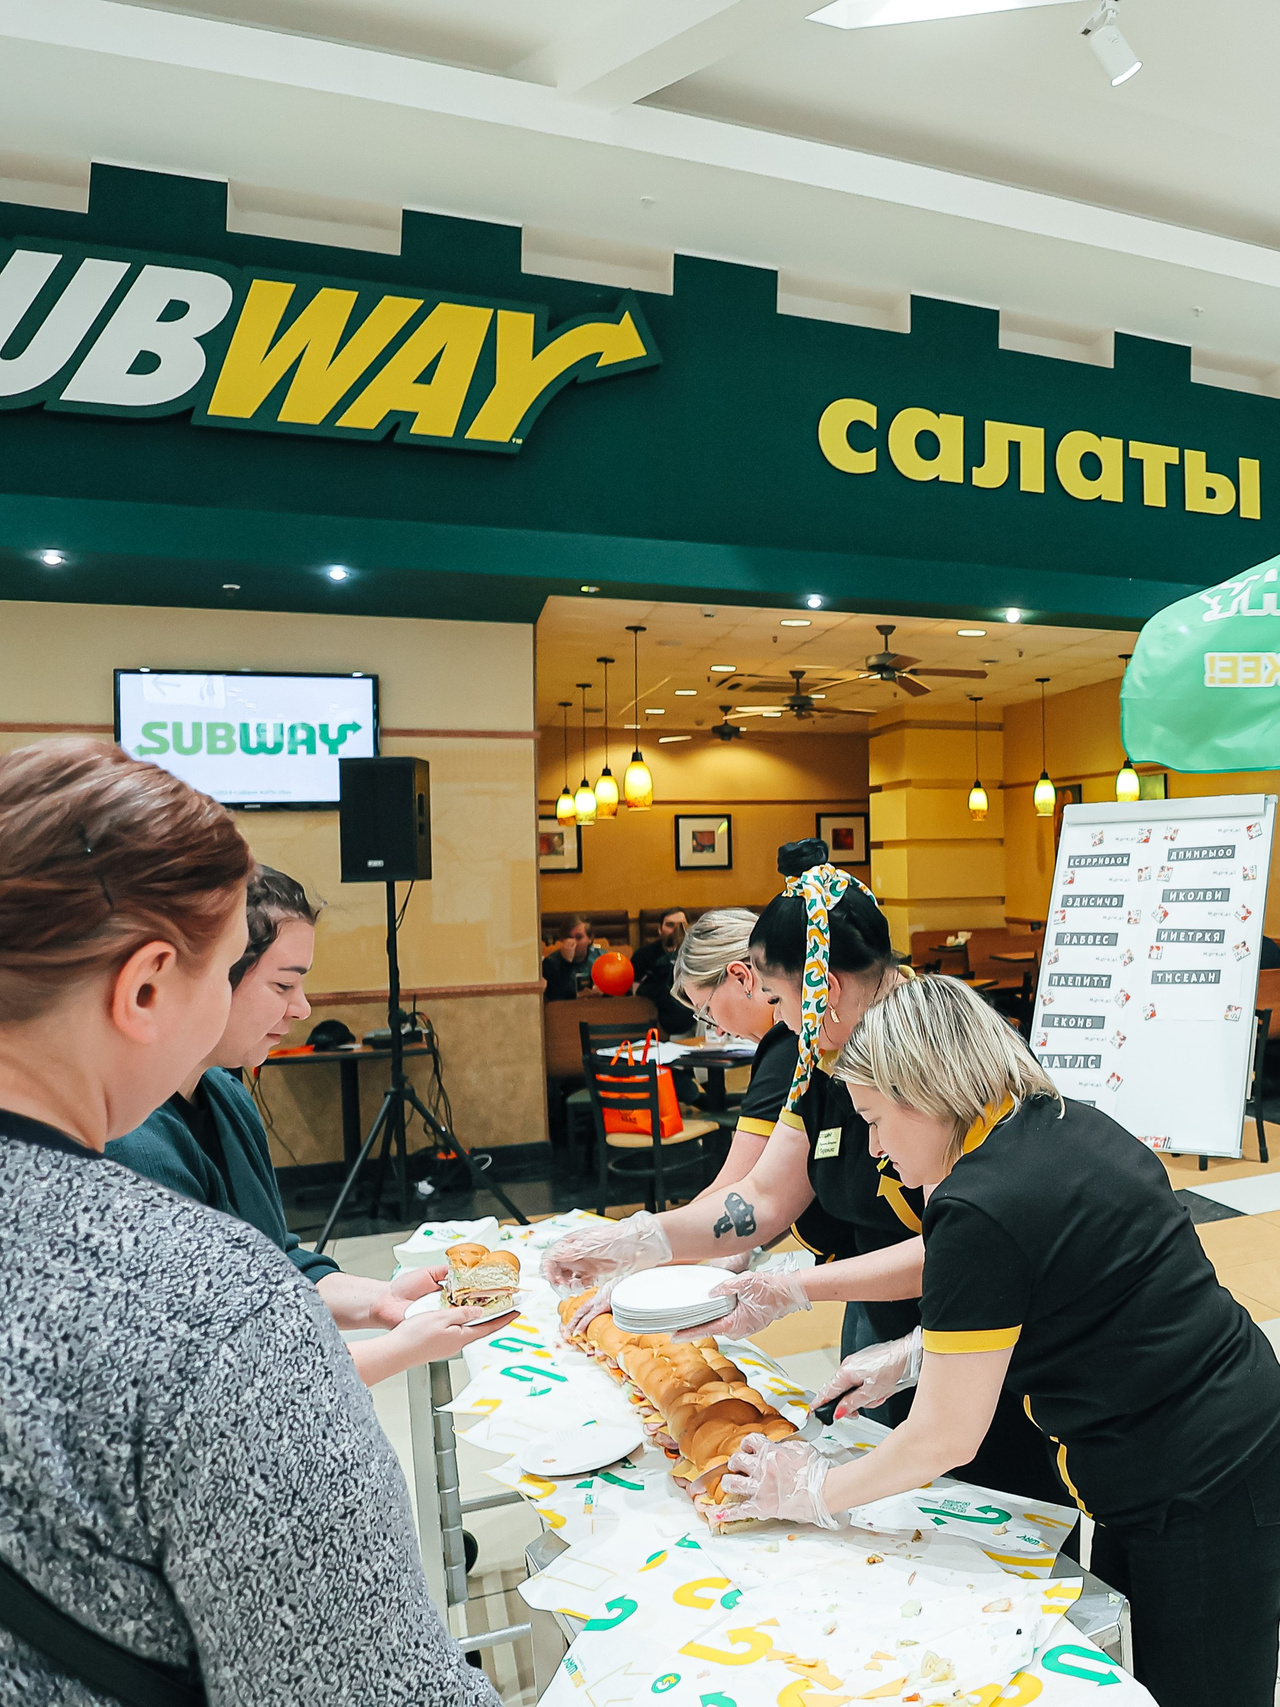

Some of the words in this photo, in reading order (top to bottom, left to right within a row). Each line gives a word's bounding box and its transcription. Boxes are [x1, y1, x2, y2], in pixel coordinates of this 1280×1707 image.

[817, 398, 1261, 520] салаты
[132, 721, 362, 757] SUBWAY
[1066, 896, 1118, 907] ЭДНСИЧВ
[1169, 890, 1222, 902] ИКОЛВИ
[1063, 933, 1109, 945] ЙАБВЕС
[1160, 931, 1221, 942] ИИЕТРКЯ
[1051, 975, 1108, 987] ПАЕПИТТ
[1156, 972, 1216, 983] ТМСЕААН
[1053, 1016, 1092, 1028] ЕКОНБ
[1041, 1055, 1096, 1068] ААТЛС
